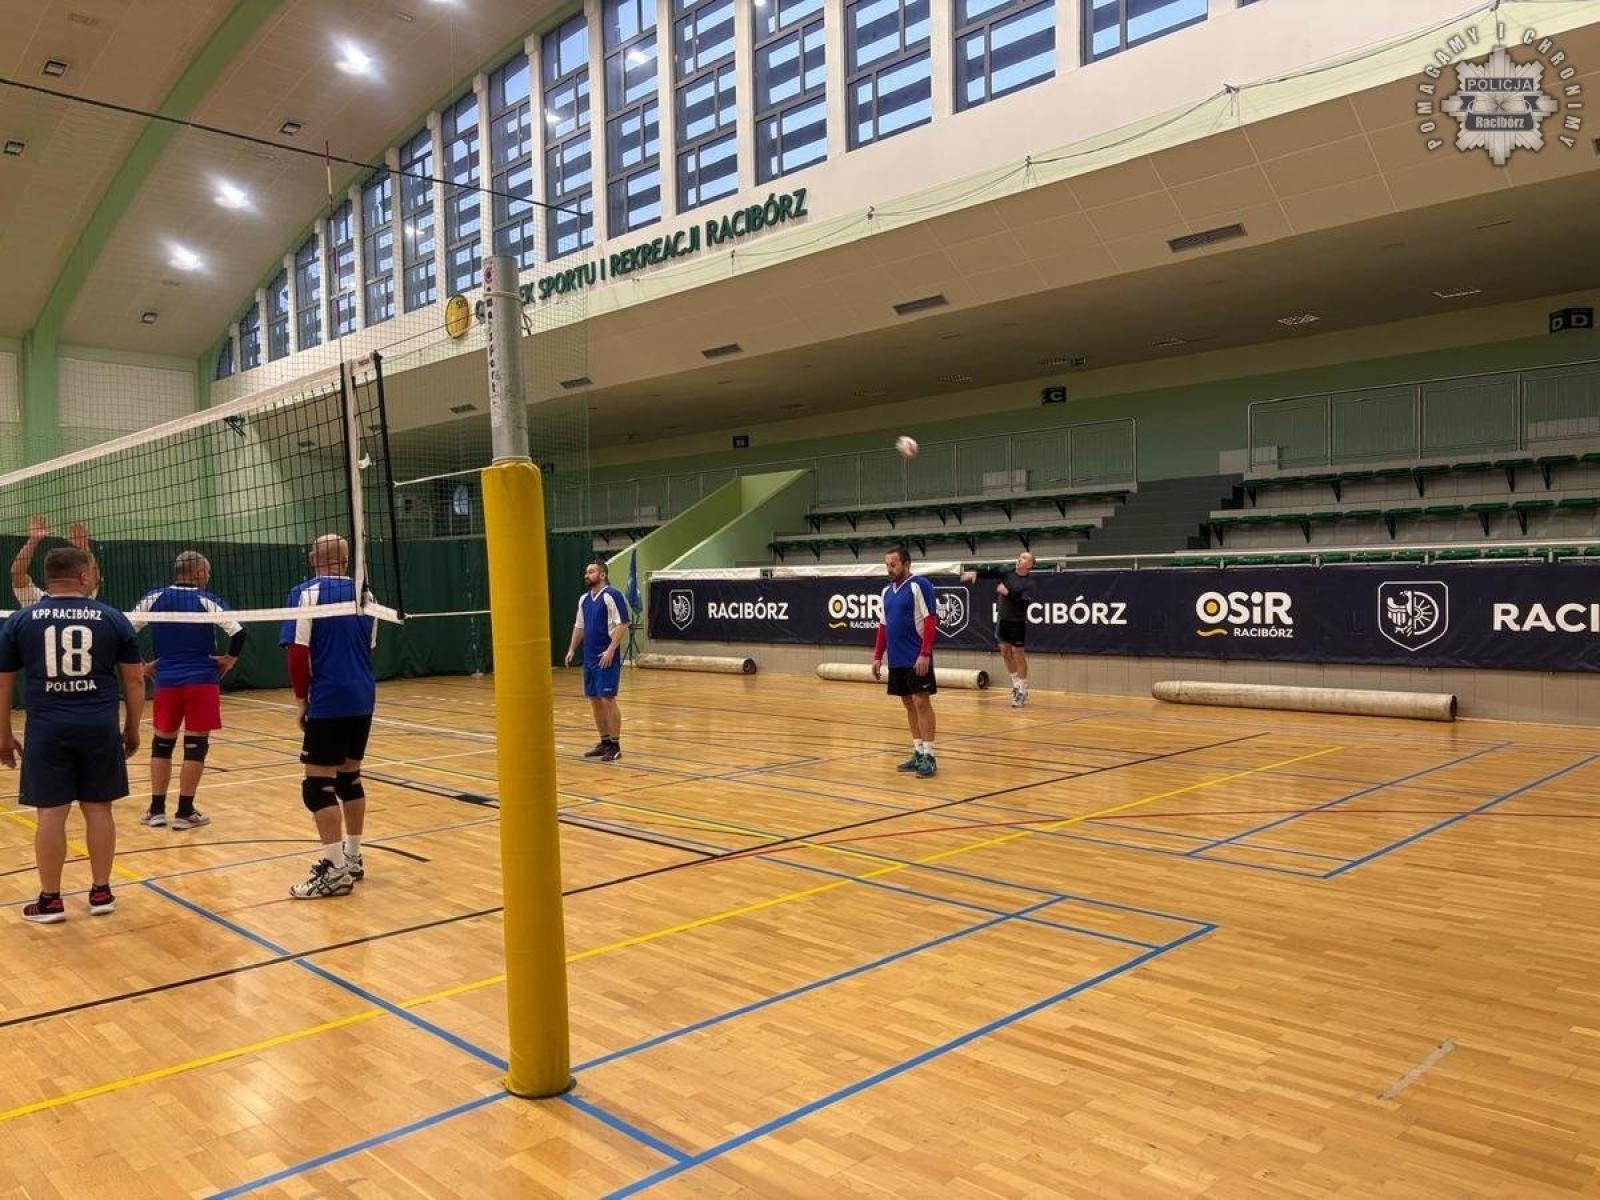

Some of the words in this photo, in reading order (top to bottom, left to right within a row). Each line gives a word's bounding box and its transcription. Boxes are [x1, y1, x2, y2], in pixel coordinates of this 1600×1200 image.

[539, 261, 596, 301] SPORTU
[600, 258, 606, 281] I
[610, 225, 701, 278] REKREACJI
[705, 187, 808, 247] RACIBÓRZ
[1571, 314, 1588, 327] D
[1050, 391, 1063, 401] C
[31, 608, 51, 620] KPP
[52, 606, 102, 621] RACIBÓRZ
[707, 597, 789, 620] RACIBÓRZ
[992, 595, 1128, 625] CIBÓRZ
[1195, 591, 1293, 625] OSiR
[849, 620, 881, 629] RACIBÓR
[1493, 603, 1600, 633] RACI
[1233, 626, 1294, 638] RACIBÓRZ
[44, 624, 93, 678] 18
[45, 680, 97, 692] POLICJA
